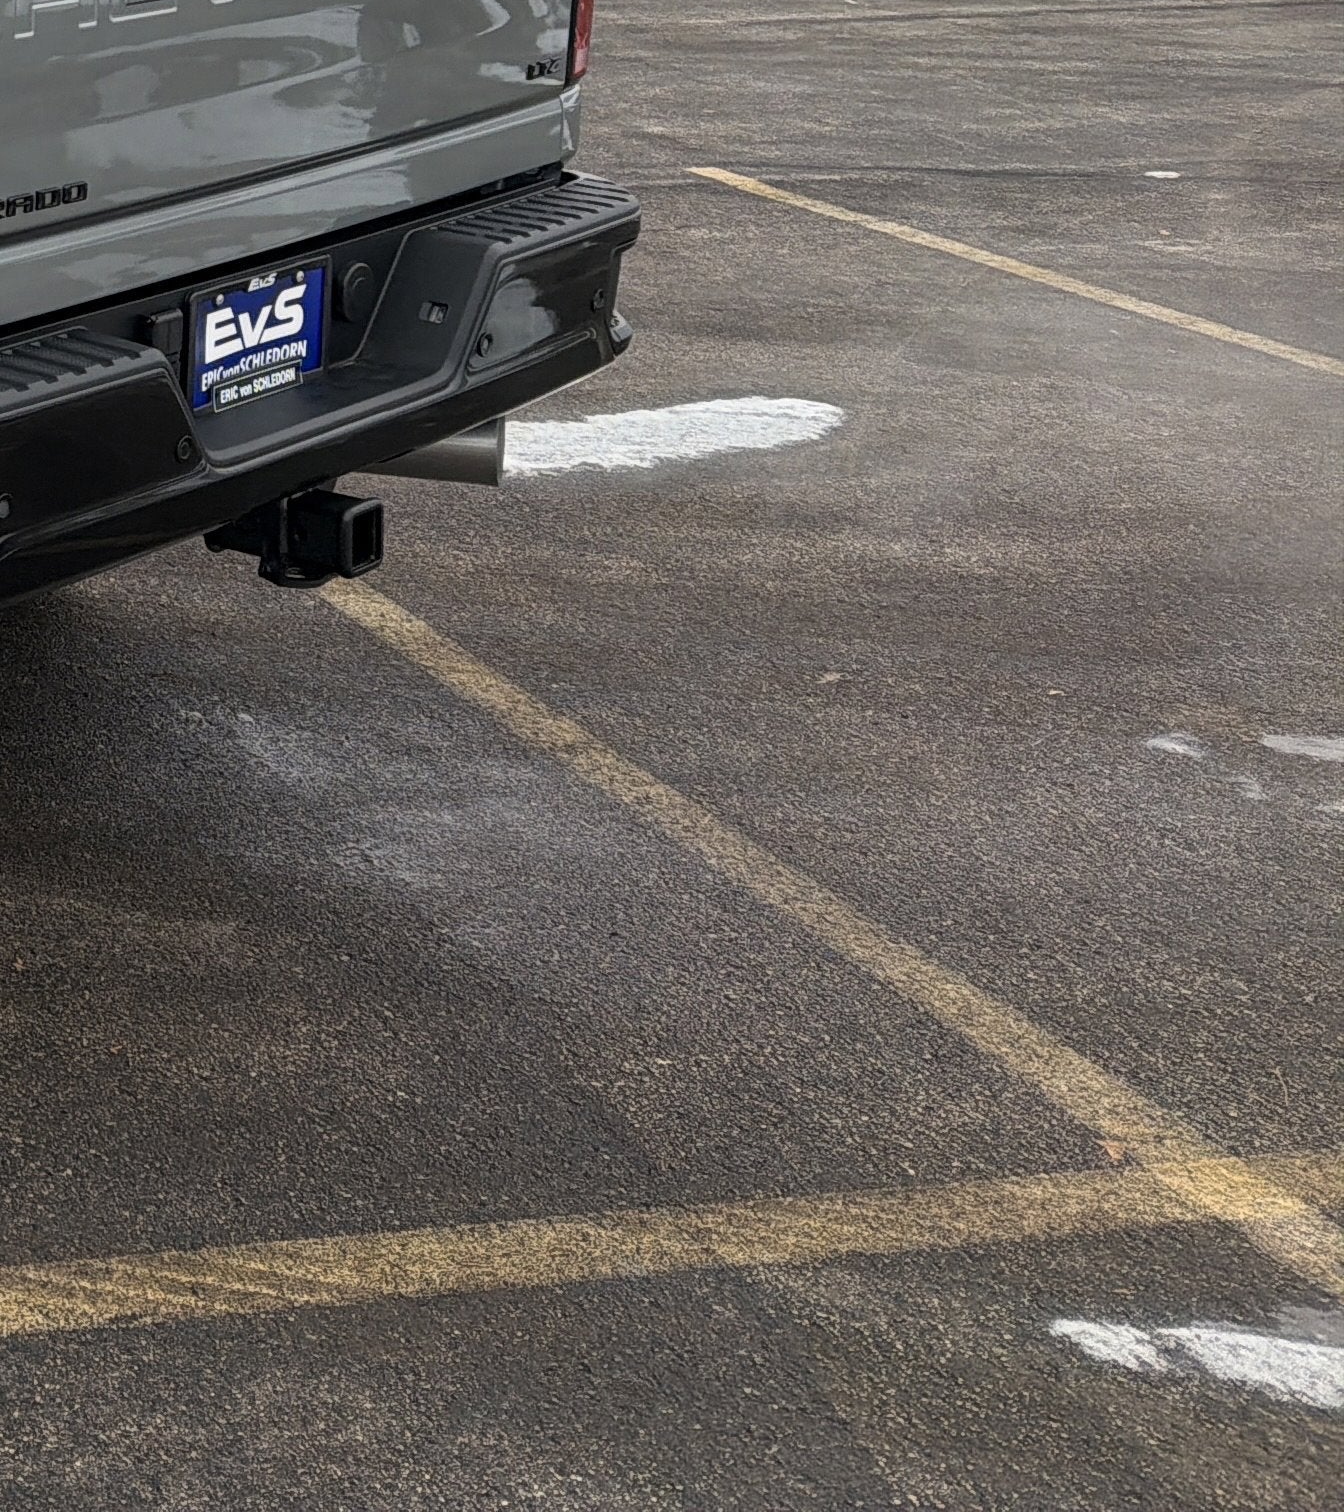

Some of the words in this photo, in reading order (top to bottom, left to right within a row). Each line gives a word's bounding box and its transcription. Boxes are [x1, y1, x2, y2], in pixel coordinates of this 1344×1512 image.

[220, 384, 238, 404] ERIC
[239, 384, 253, 398] von
[253, 367, 296, 393] SCHLEDORN
